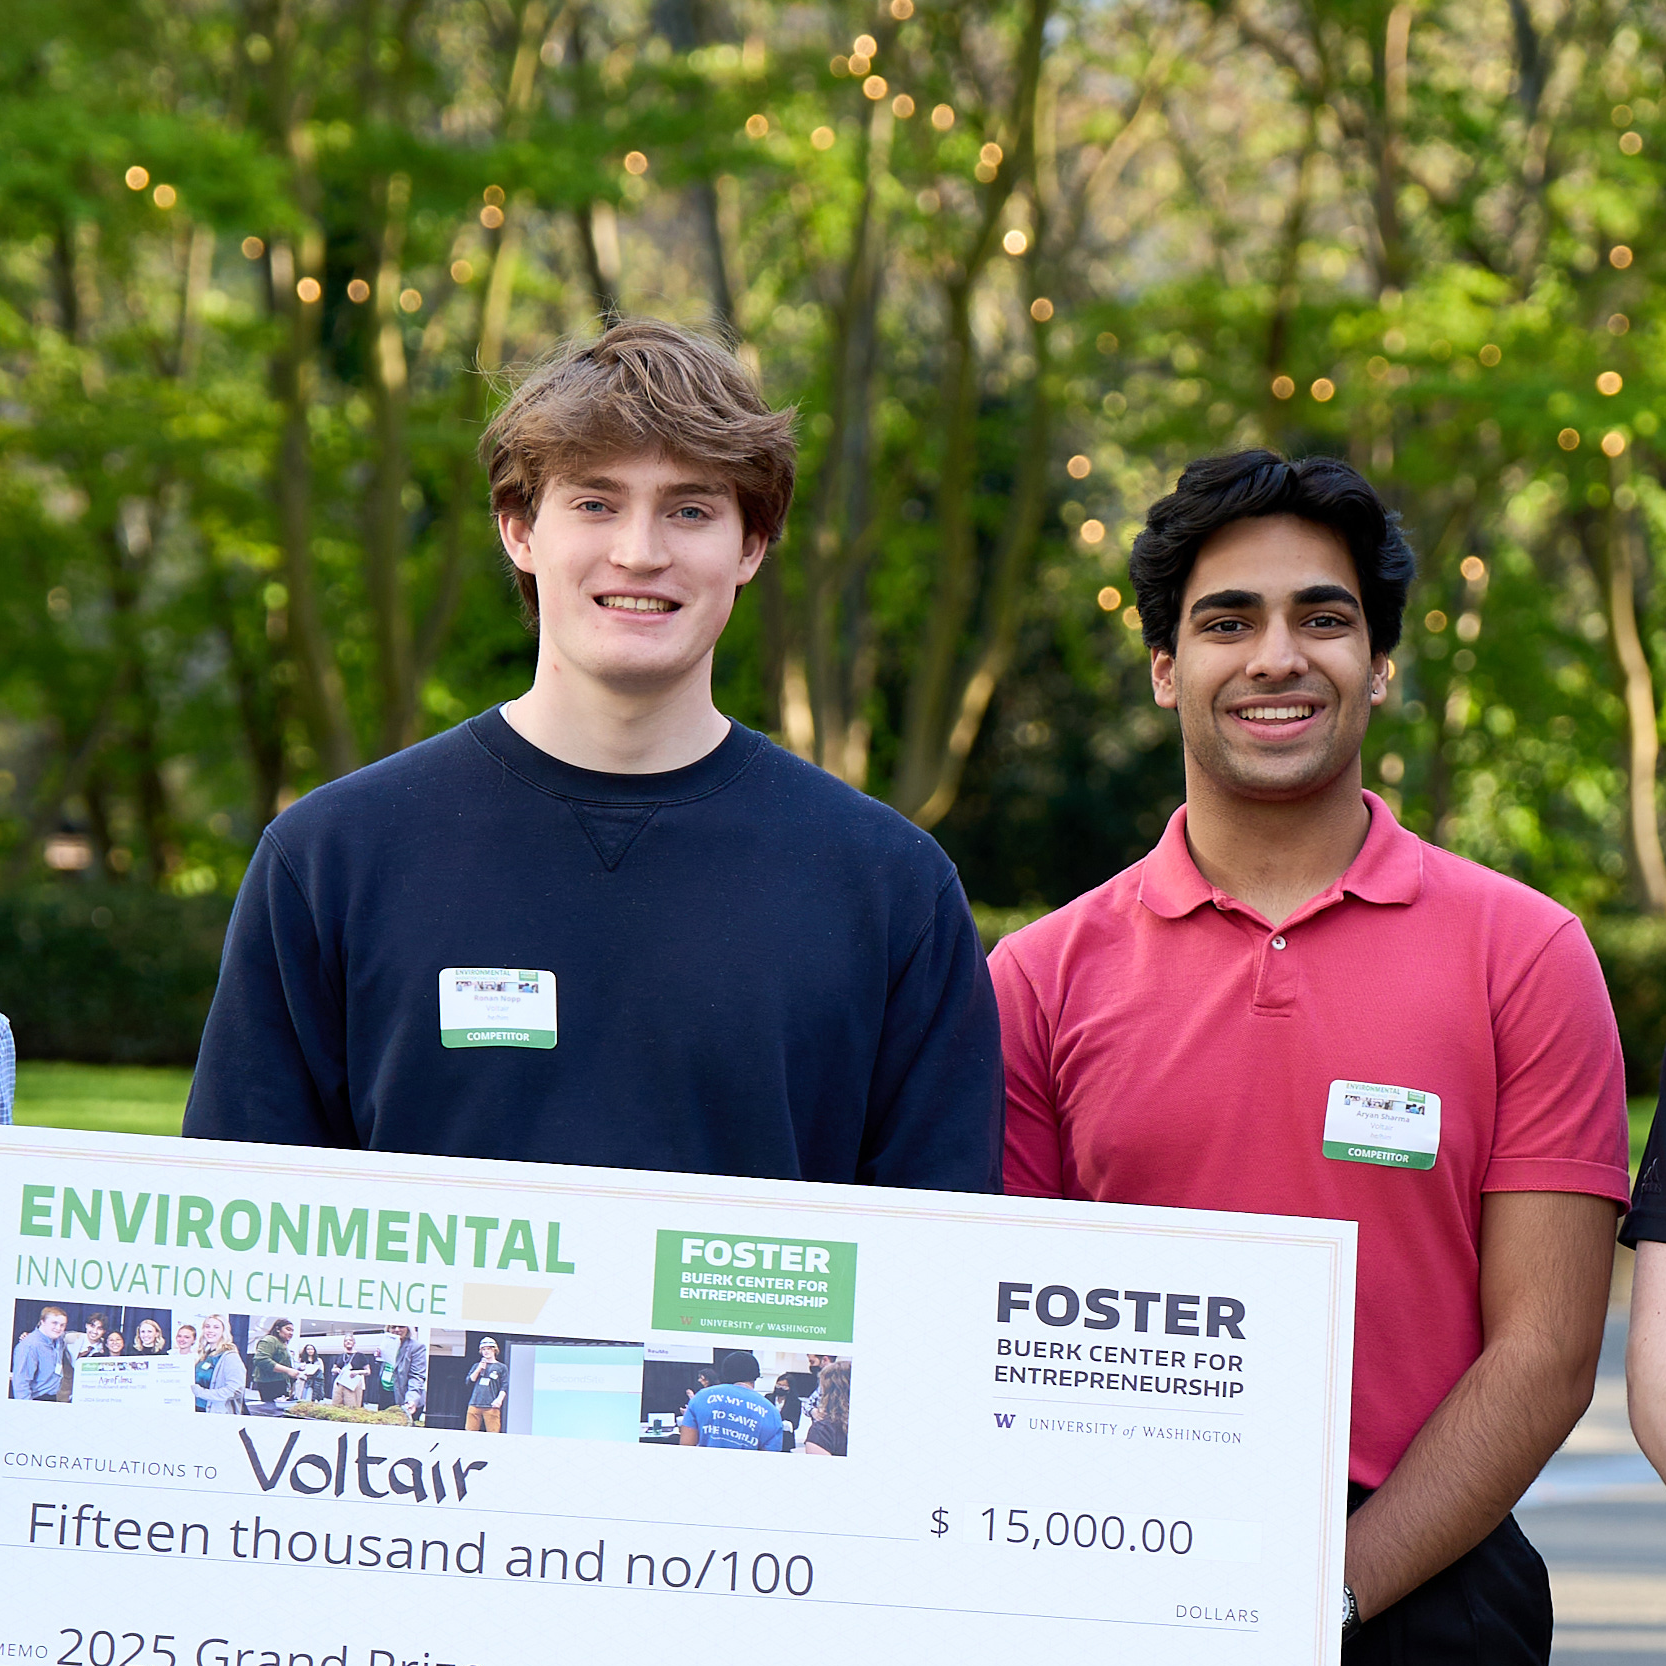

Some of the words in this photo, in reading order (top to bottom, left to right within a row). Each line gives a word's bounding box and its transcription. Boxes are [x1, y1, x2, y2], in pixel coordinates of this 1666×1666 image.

[466, 1032, 530, 1042] COMPETITOR
[1356, 1110, 1379, 1119] Aryan
[1381, 1113, 1410, 1123] Sharma
[1348, 1147, 1410, 1163] COMPETITOR
[19, 1184, 576, 1274] ENVIRONMENTAL
[681, 1238, 830, 1273] FOSTER
[16, 1254, 233, 1300] INNOVATION
[245, 1271, 448, 1315] CHALLENGE
[681, 1272, 733, 1286] BUERK
[736, 1276, 794, 1290] CENTER
[797, 1280, 828, 1292] FOR
[680, 1287, 829, 1308] ENTREPRENEURSHIP
[997, 1282, 1246, 1340] FOSTER
[700, 1318, 753, 1330] UNIVERSITY
[755, 1322, 765, 1332] of
[767, 1323, 827, 1334] WASHINGTON
[997, 1338, 1083, 1361] BUERK
[1089, 1345, 1186, 1368] CENTER
[1194, 1352, 1243, 1372] FOR
[994, 1365, 1244, 1399] ENTREPRENEURSHIP
[712, 1409, 726, 1420] TO
[728, 1413, 757, 1431] SAVE
[994, 1413, 1016, 1429] W
[1029, 1418, 1118, 1436] UNIVERSITY
[1122, 1426, 1137, 1440] of
[1143, 1426, 1242, 1444] WASHINGTON
[702, 1424, 720, 1435] THE
[721, 1427, 759, 1446] WORLD
[4, 1452, 187, 1477] CONGRATULATIONS
[195, 1465, 218, 1480] TO
[238, 1427, 488, 1504] Voltair
[930, 1506, 949, 1538] $
[981, 1507, 1193, 1554] 15,000.00
[28, 1502, 209, 1555] Fifteen
[229, 1515, 486, 1574] thousand
[506, 1539, 604, 1582] and
[626, 1549, 814, 1596] no/100
[1176, 1604, 1259, 1623] DOLLARS
